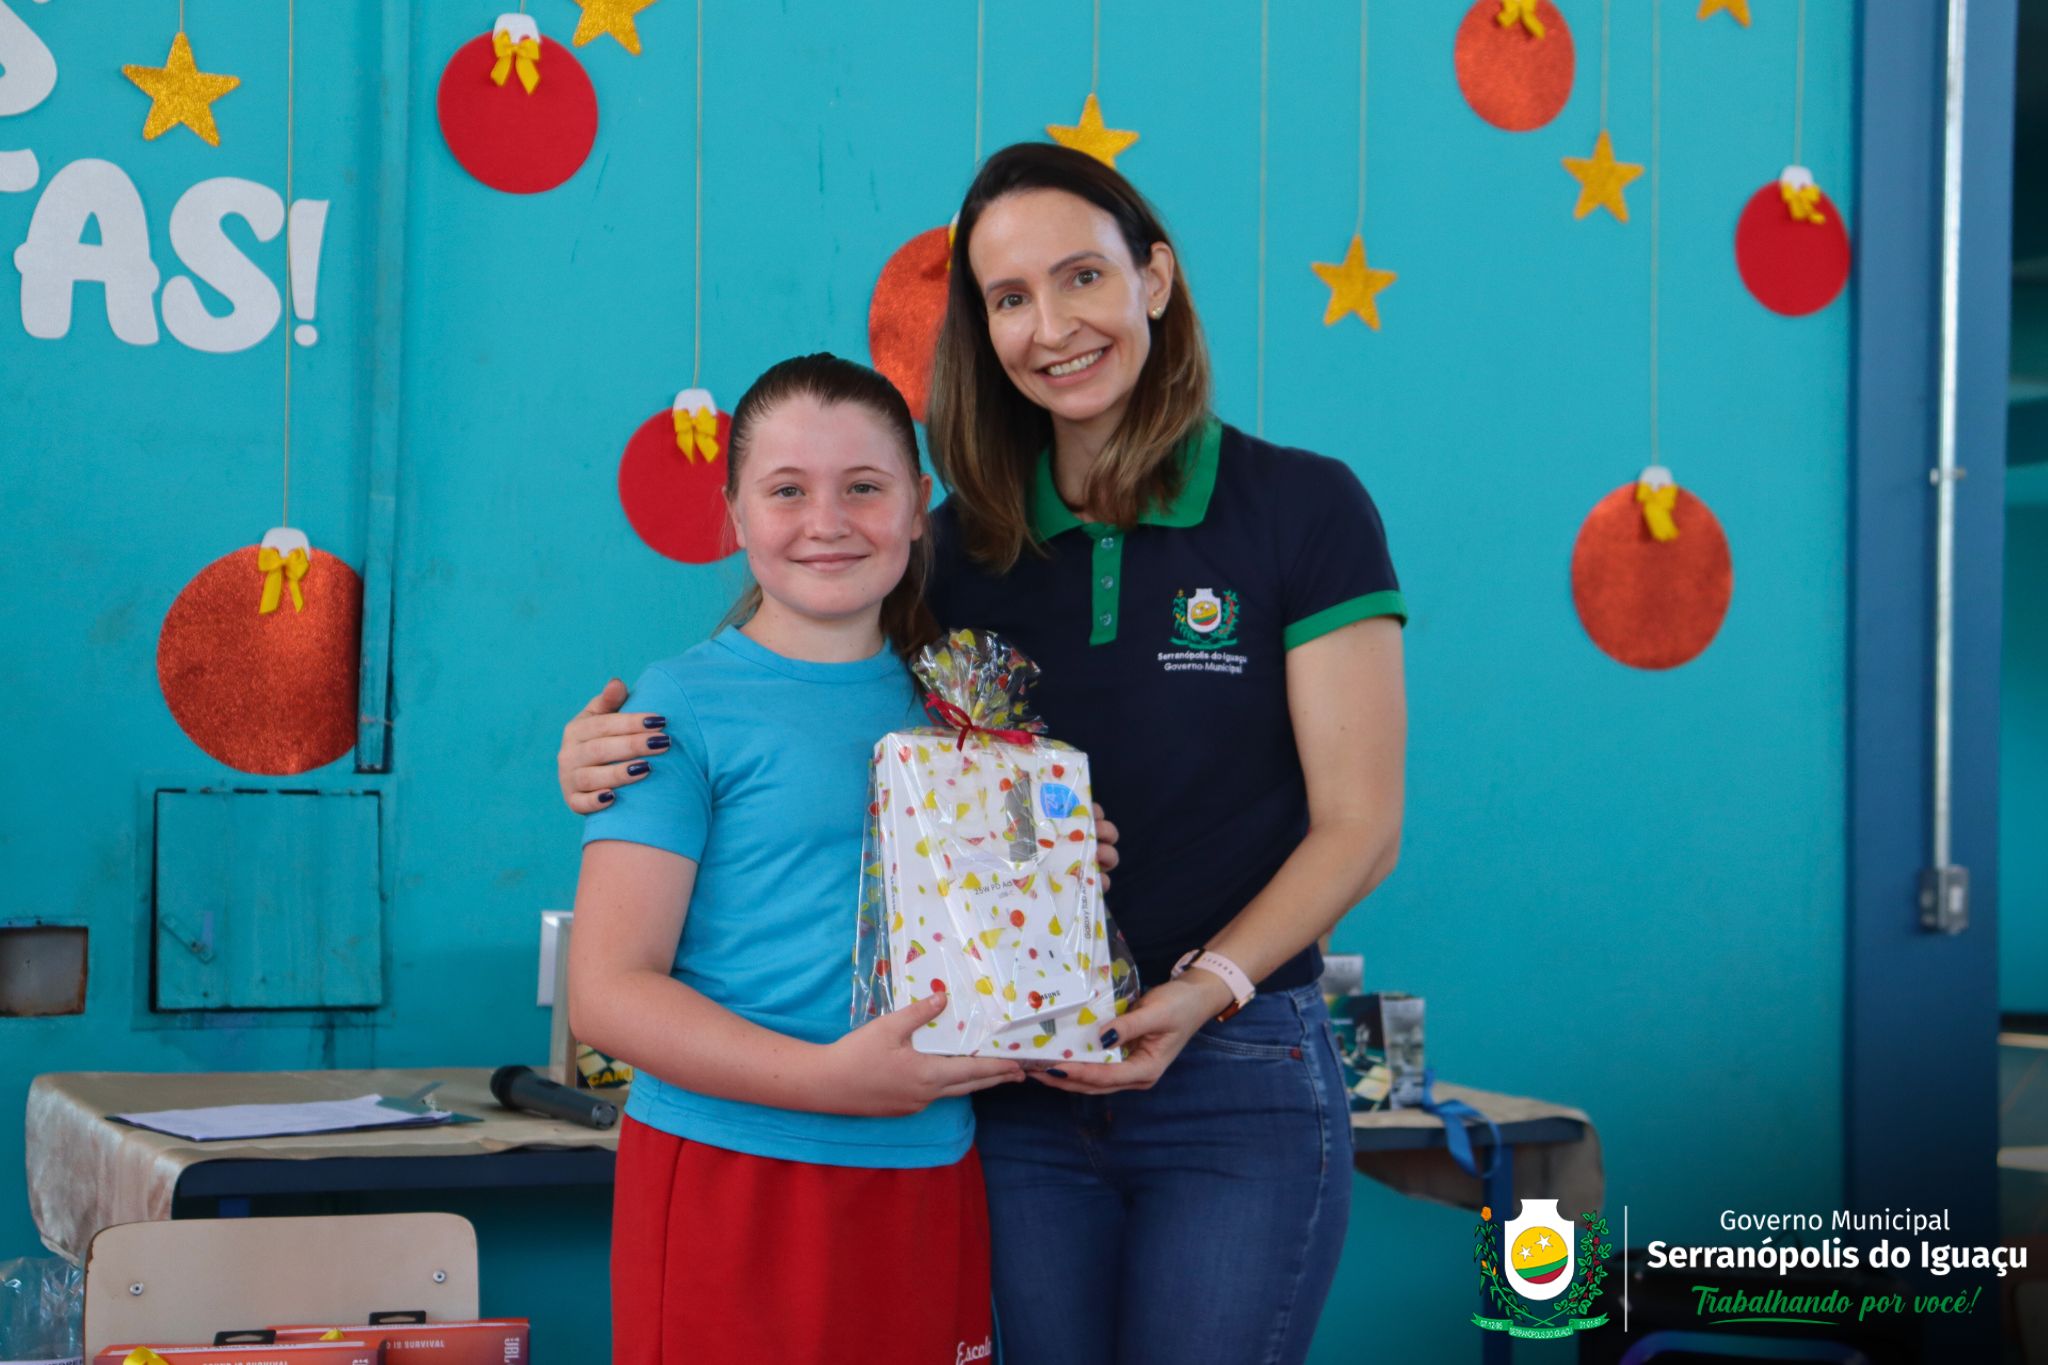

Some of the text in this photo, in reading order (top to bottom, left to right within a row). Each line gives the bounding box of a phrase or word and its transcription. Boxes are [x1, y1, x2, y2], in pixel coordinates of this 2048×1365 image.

[0, 148, 329, 353] AS!
[1157, 651, 1209, 661] Serranópolis
[1211, 652, 1221, 661] do
[1164, 662, 1243, 674] Governo Municipal
[1083, 911, 1092, 940] Galaxy
[404, 1339, 445, 1349] SURVIVAL
